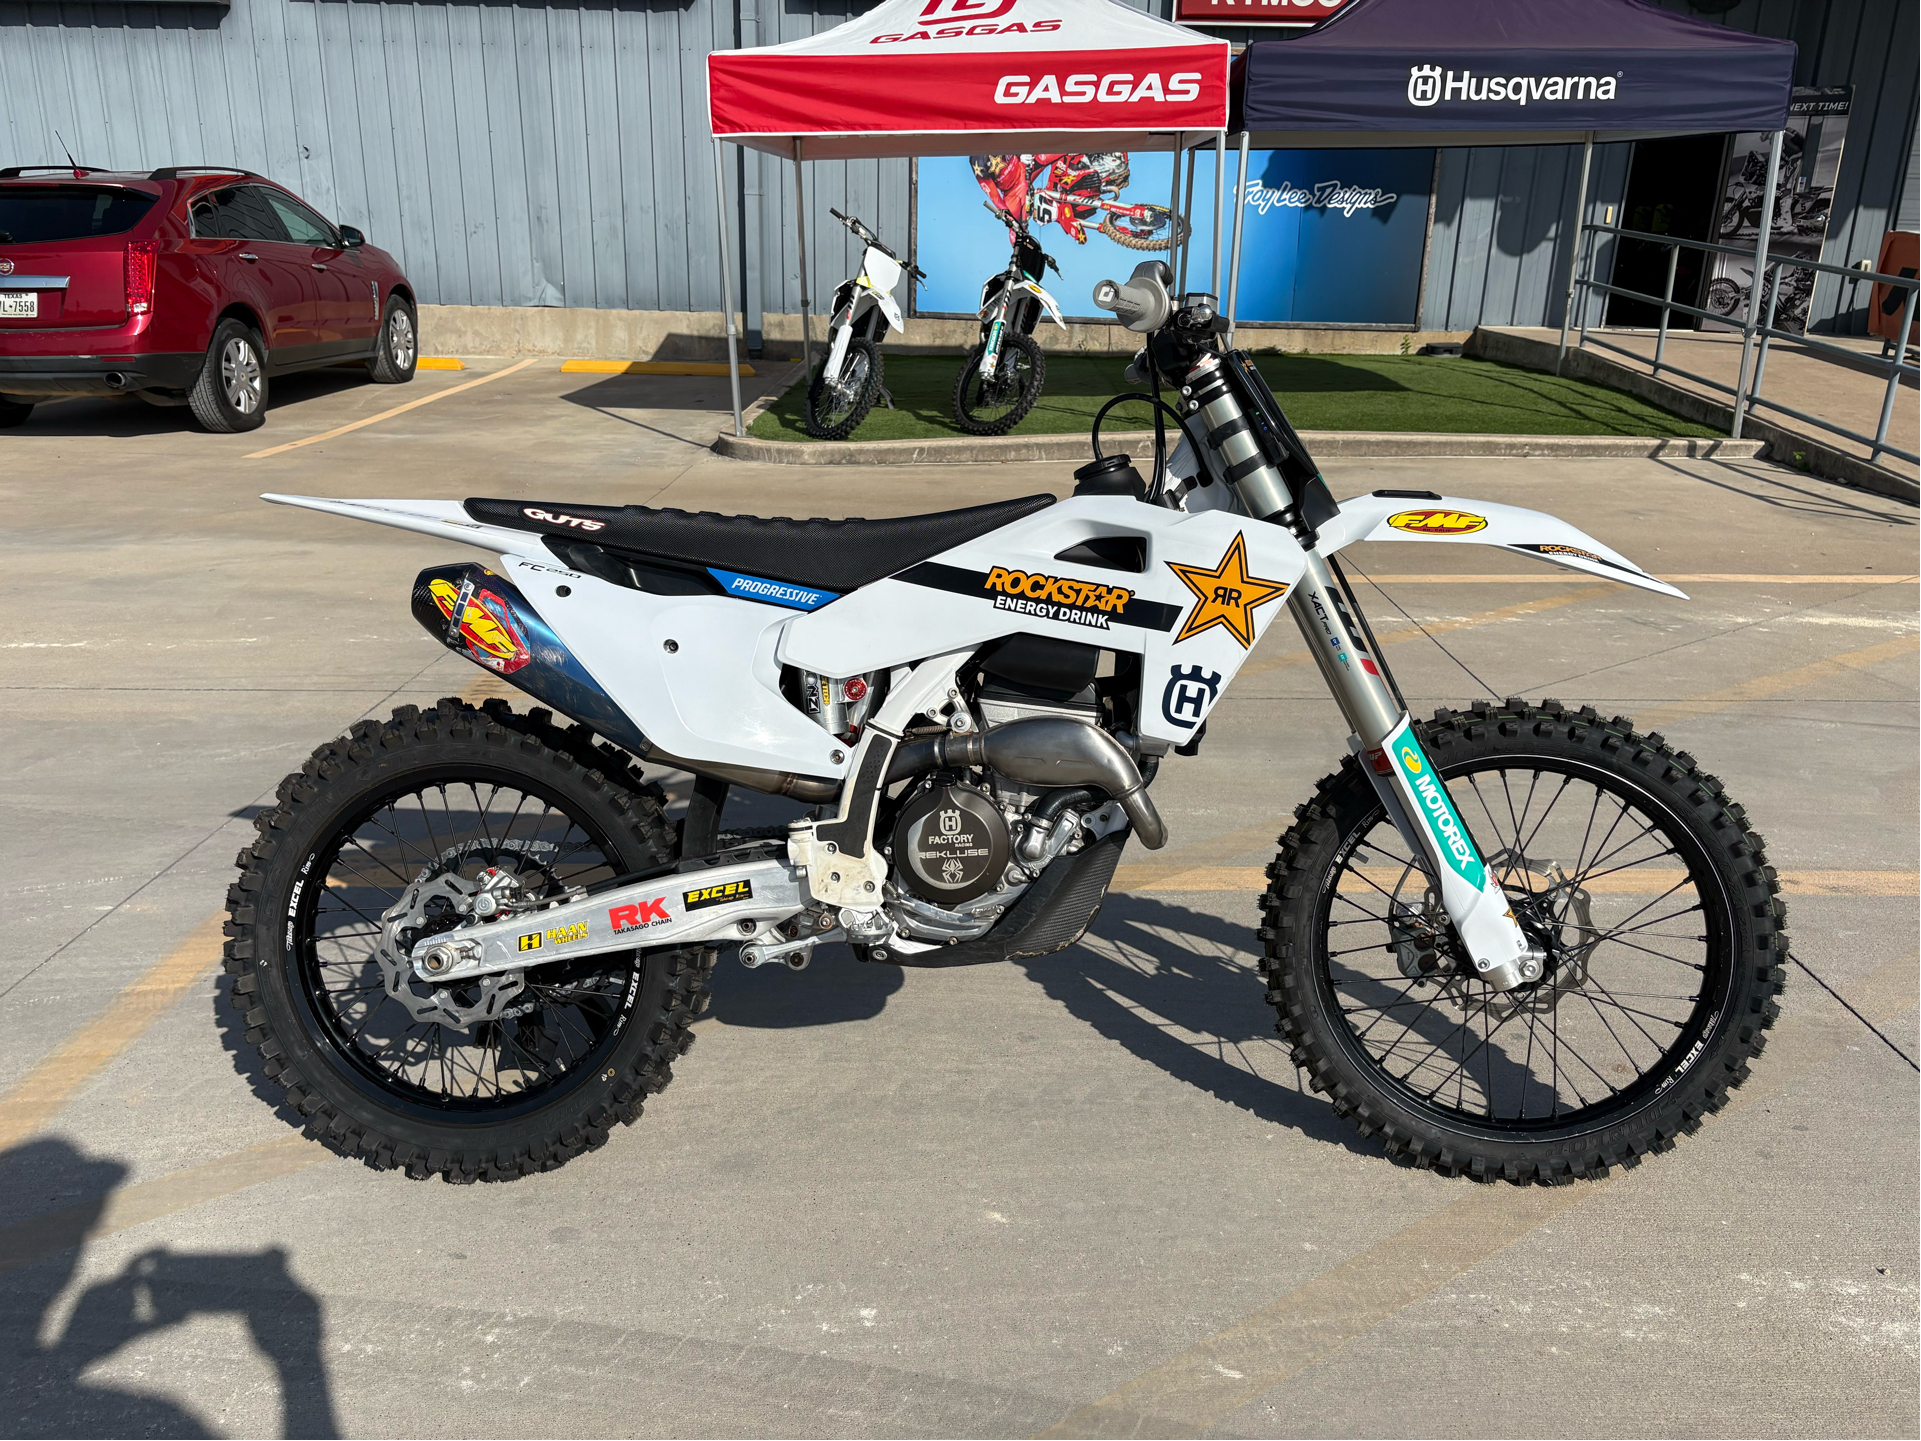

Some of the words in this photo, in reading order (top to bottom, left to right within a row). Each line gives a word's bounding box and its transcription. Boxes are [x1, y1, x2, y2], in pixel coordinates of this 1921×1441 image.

[869, 19, 1063, 44] GASGAS
[994, 72, 1202, 104] GASGAS
[1444, 70, 1617, 105] Husqvarna
[1817, 101, 1849, 110] TIME!
[1274, 181, 1313, 207] Lee
[1313, 180, 1398, 218] Designs
[523, 508, 606, 531] GUTS
[1390, 513, 1485, 529] FMF
[518, 561, 546, 572] FC
[546, 567, 582, 579] 250
[731, 578, 820, 605] PROGRESSIVE
[984, 567, 1131, 613] ROCKSTAR
[995, 596, 1058, 618] ENERGY
[1058, 605, 1110, 628] DRINK
[1308, 591, 1329, 621] XACT
[1415, 774, 1475, 871] MOTOREX
[918, 848, 989, 859] REKLUSE
[928, 834, 974, 845] FACTORY
[1335, 832, 1361, 864] EXCEL
[288, 880, 304, 918] EXCEL
[687, 882, 749, 903] EXCEL
[609, 896, 671, 930] RK
[613, 923, 649, 935] TAKASAGO
[651, 918, 672, 927] CHAIN
[546, 921, 589, 940] HAAN
[554, 931, 589, 946] WHEELS
[624, 971, 640, 1010] EXCEL
[1675, 1040, 1704, 1073] EXCEL
